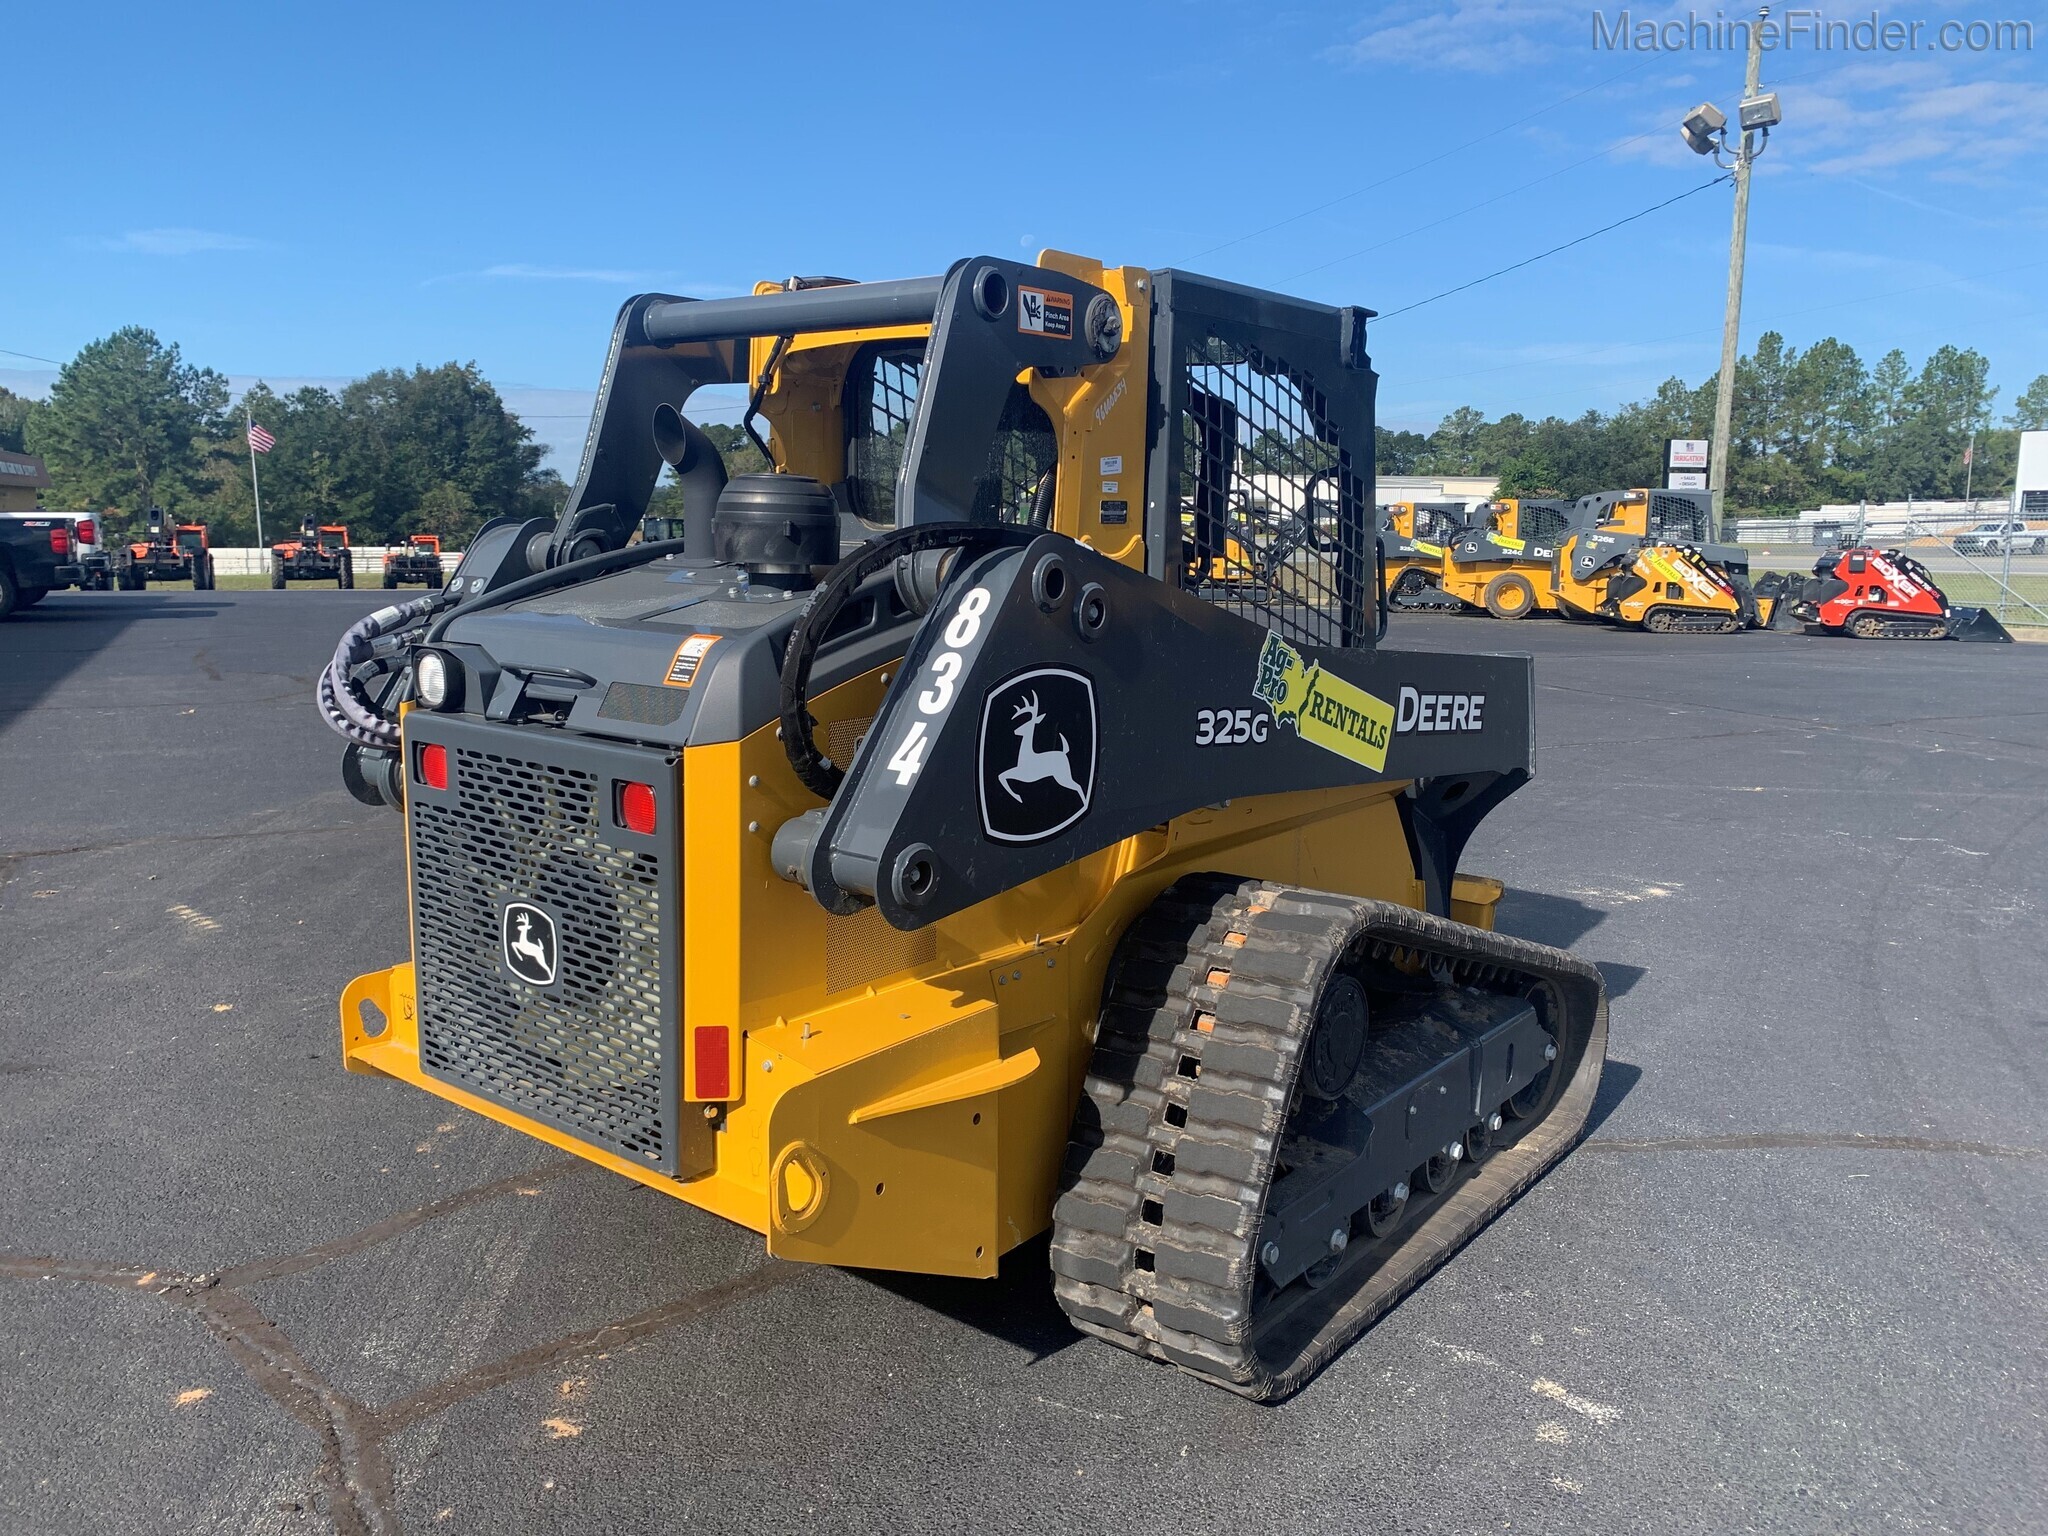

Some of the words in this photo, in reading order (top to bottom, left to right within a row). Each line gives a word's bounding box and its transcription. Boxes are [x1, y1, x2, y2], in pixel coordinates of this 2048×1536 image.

[1045, 310, 1058, 320] Pinch
[1059, 313, 1070, 322] Area
[1045, 320, 1055, 329] Keep
[1056, 323, 1066, 331] Away
[1501, 548, 1523, 556] 324G
[1671, 558, 1719, 599] BOXER
[1871, 556, 1921, 599] BOXER
[1262, 634, 1294, 677] Ag-
[1256, 662, 1288, 704] Pro
[1195, 709, 1269, 745] 325G
[1309, 690, 1388, 751] RENTALS
[1396, 686, 1486, 733] DEERE
